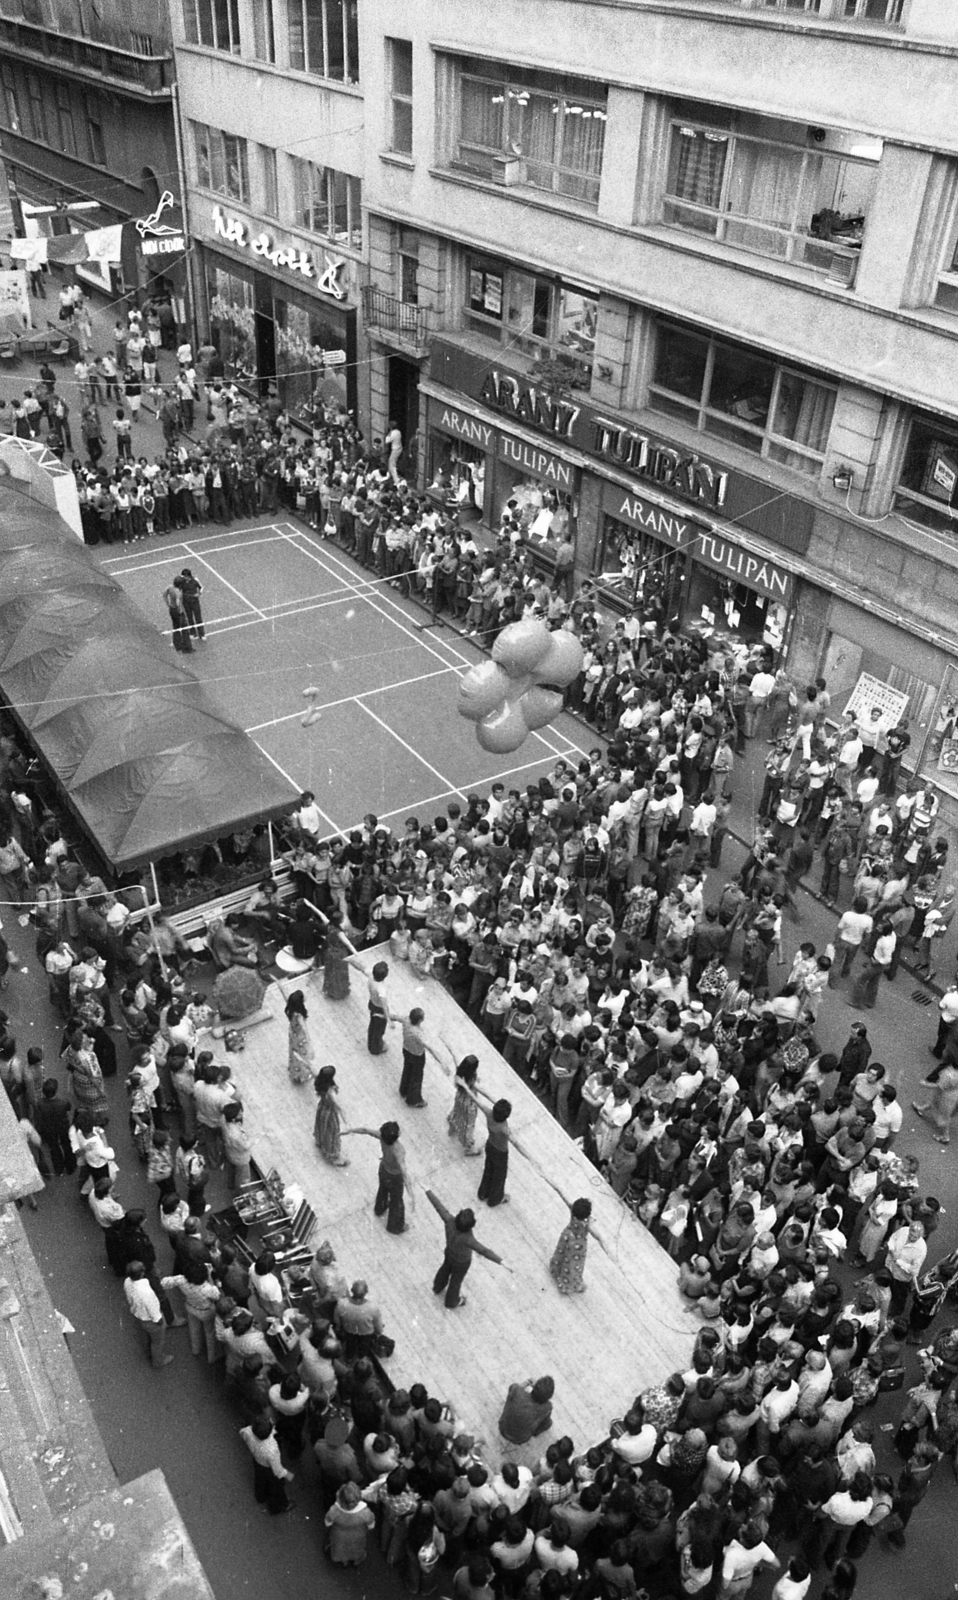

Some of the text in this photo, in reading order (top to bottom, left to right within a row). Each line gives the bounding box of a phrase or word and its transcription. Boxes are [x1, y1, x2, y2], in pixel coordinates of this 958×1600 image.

[441, 410, 570, 484] ARANY TULIPÁN
[480, 371, 728, 509] ARANY TULIPÁN
[620, 497, 788, 595] ARANY TULIPÁN
